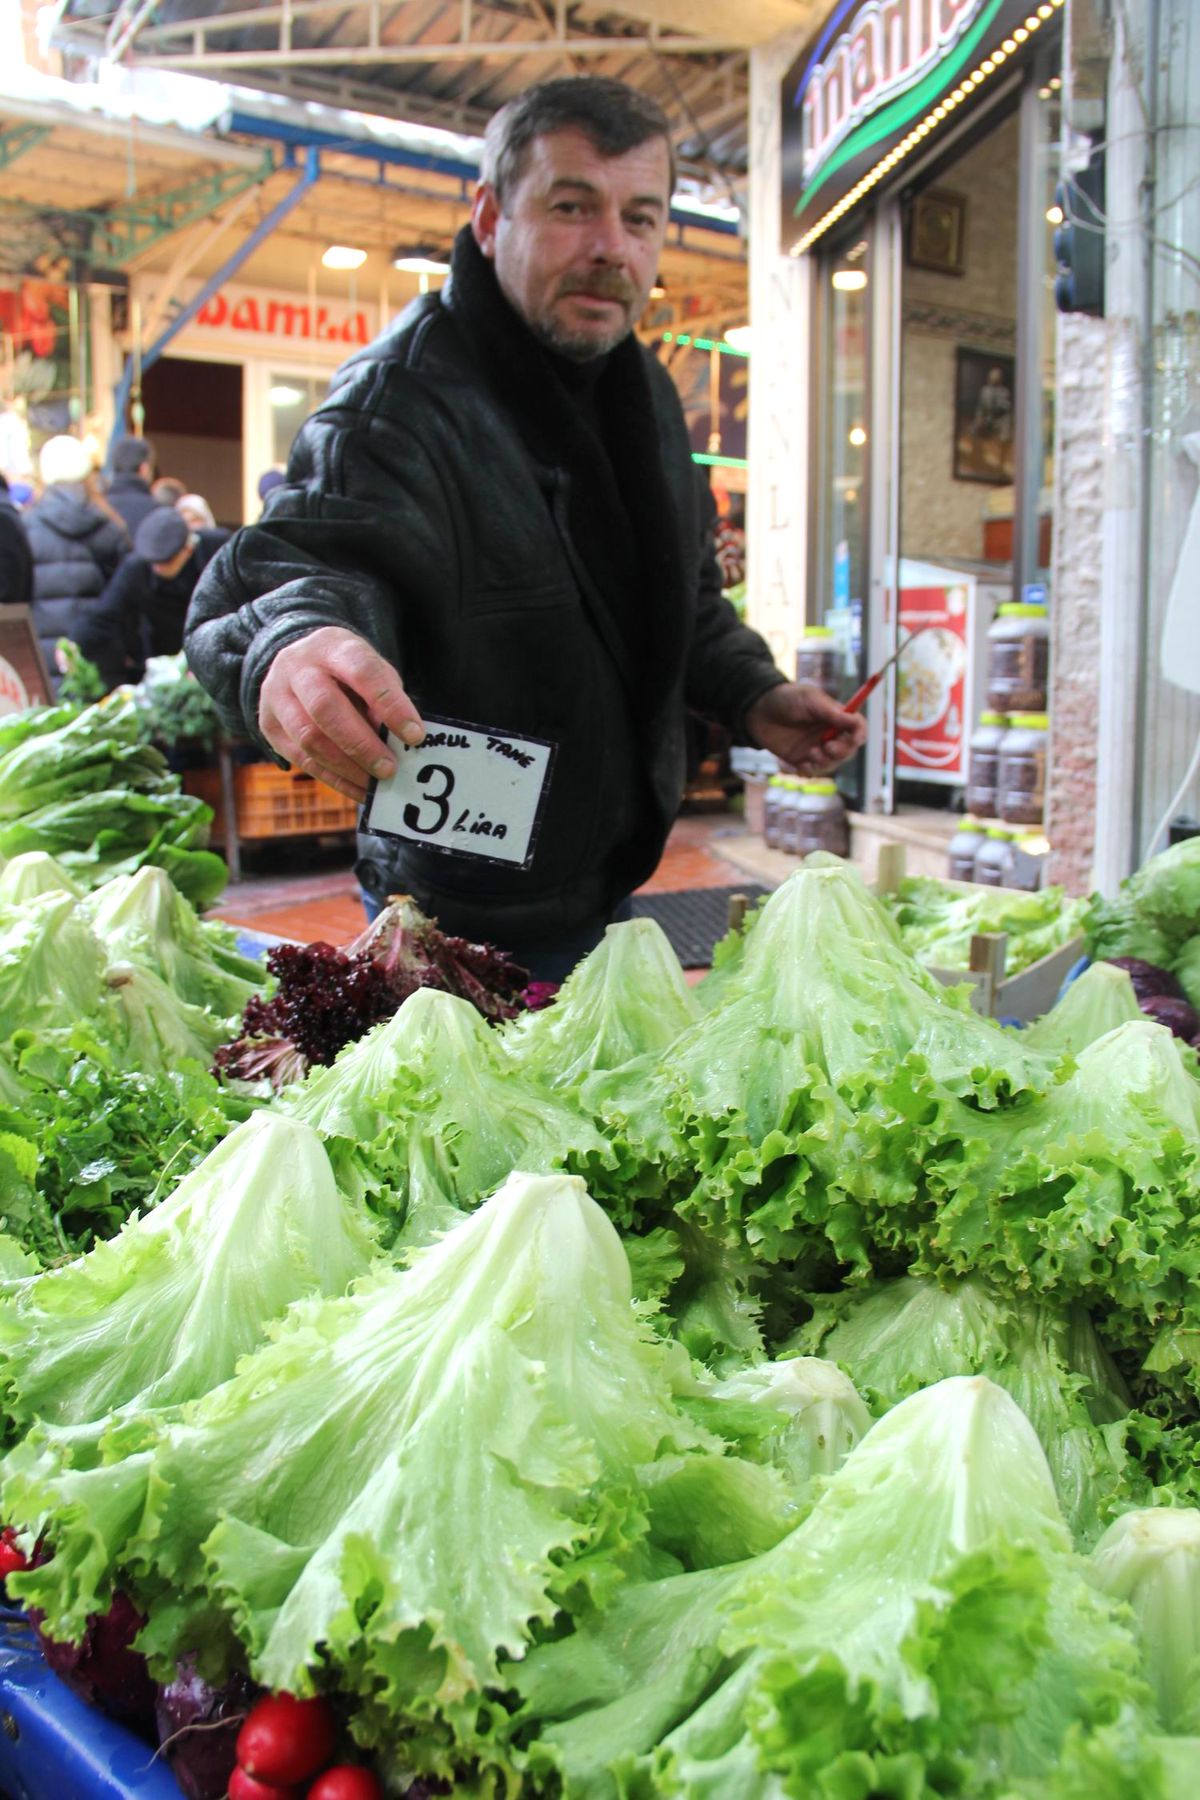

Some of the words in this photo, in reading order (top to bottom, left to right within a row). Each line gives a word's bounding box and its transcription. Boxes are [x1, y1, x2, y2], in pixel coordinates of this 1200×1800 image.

[404, 732, 471, 751] ARUL
[486, 737, 536, 768] TANE
[403, 764, 455, 834] 3
